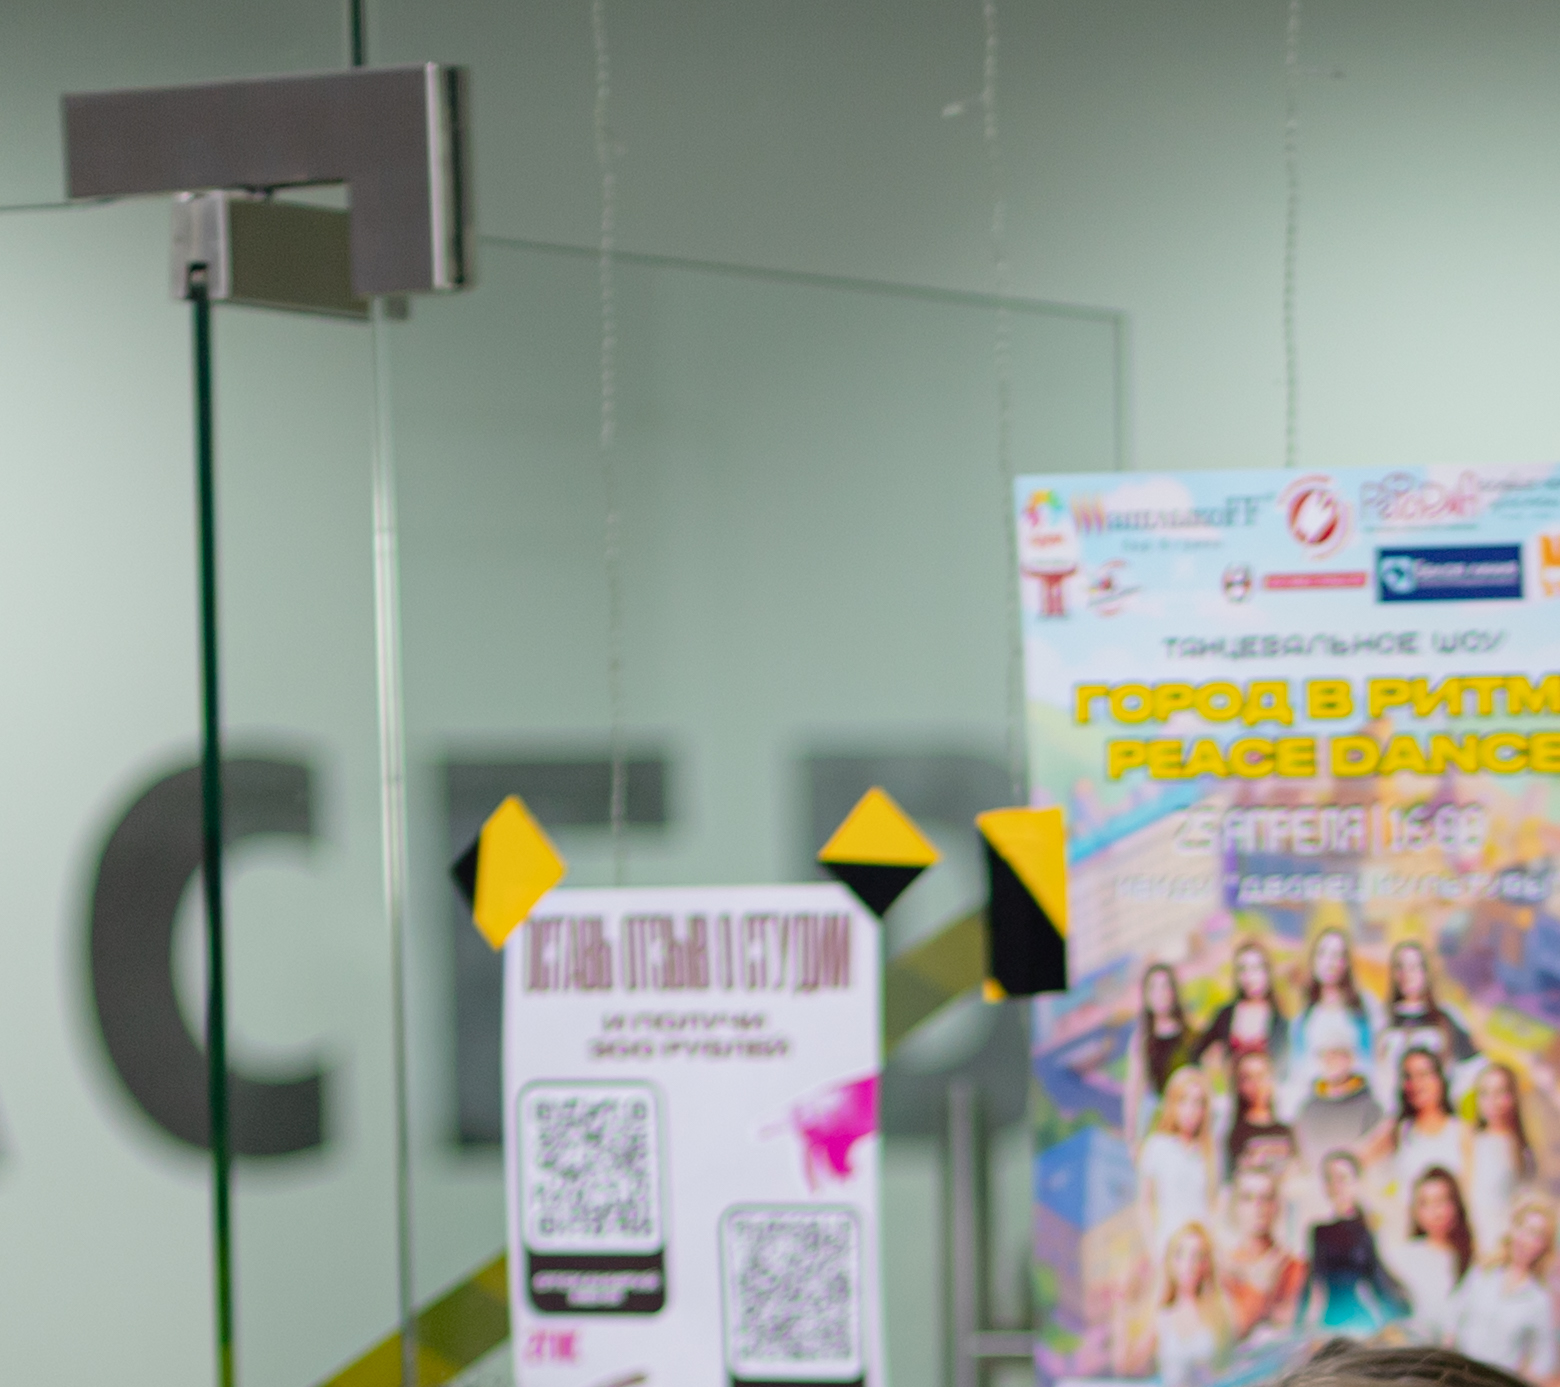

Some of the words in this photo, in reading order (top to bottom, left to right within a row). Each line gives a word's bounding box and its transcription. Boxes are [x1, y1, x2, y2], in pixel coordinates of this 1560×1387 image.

[1162, 632, 1421, 660] ТАНЦЕВАЛЬНОЕ
[1433, 630, 1507, 655] ШОУ
[1074, 679, 1295, 728] ГОРОД
[1306, 678, 1354, 720] В
[1105, 736, 1318, 781] PEACE
